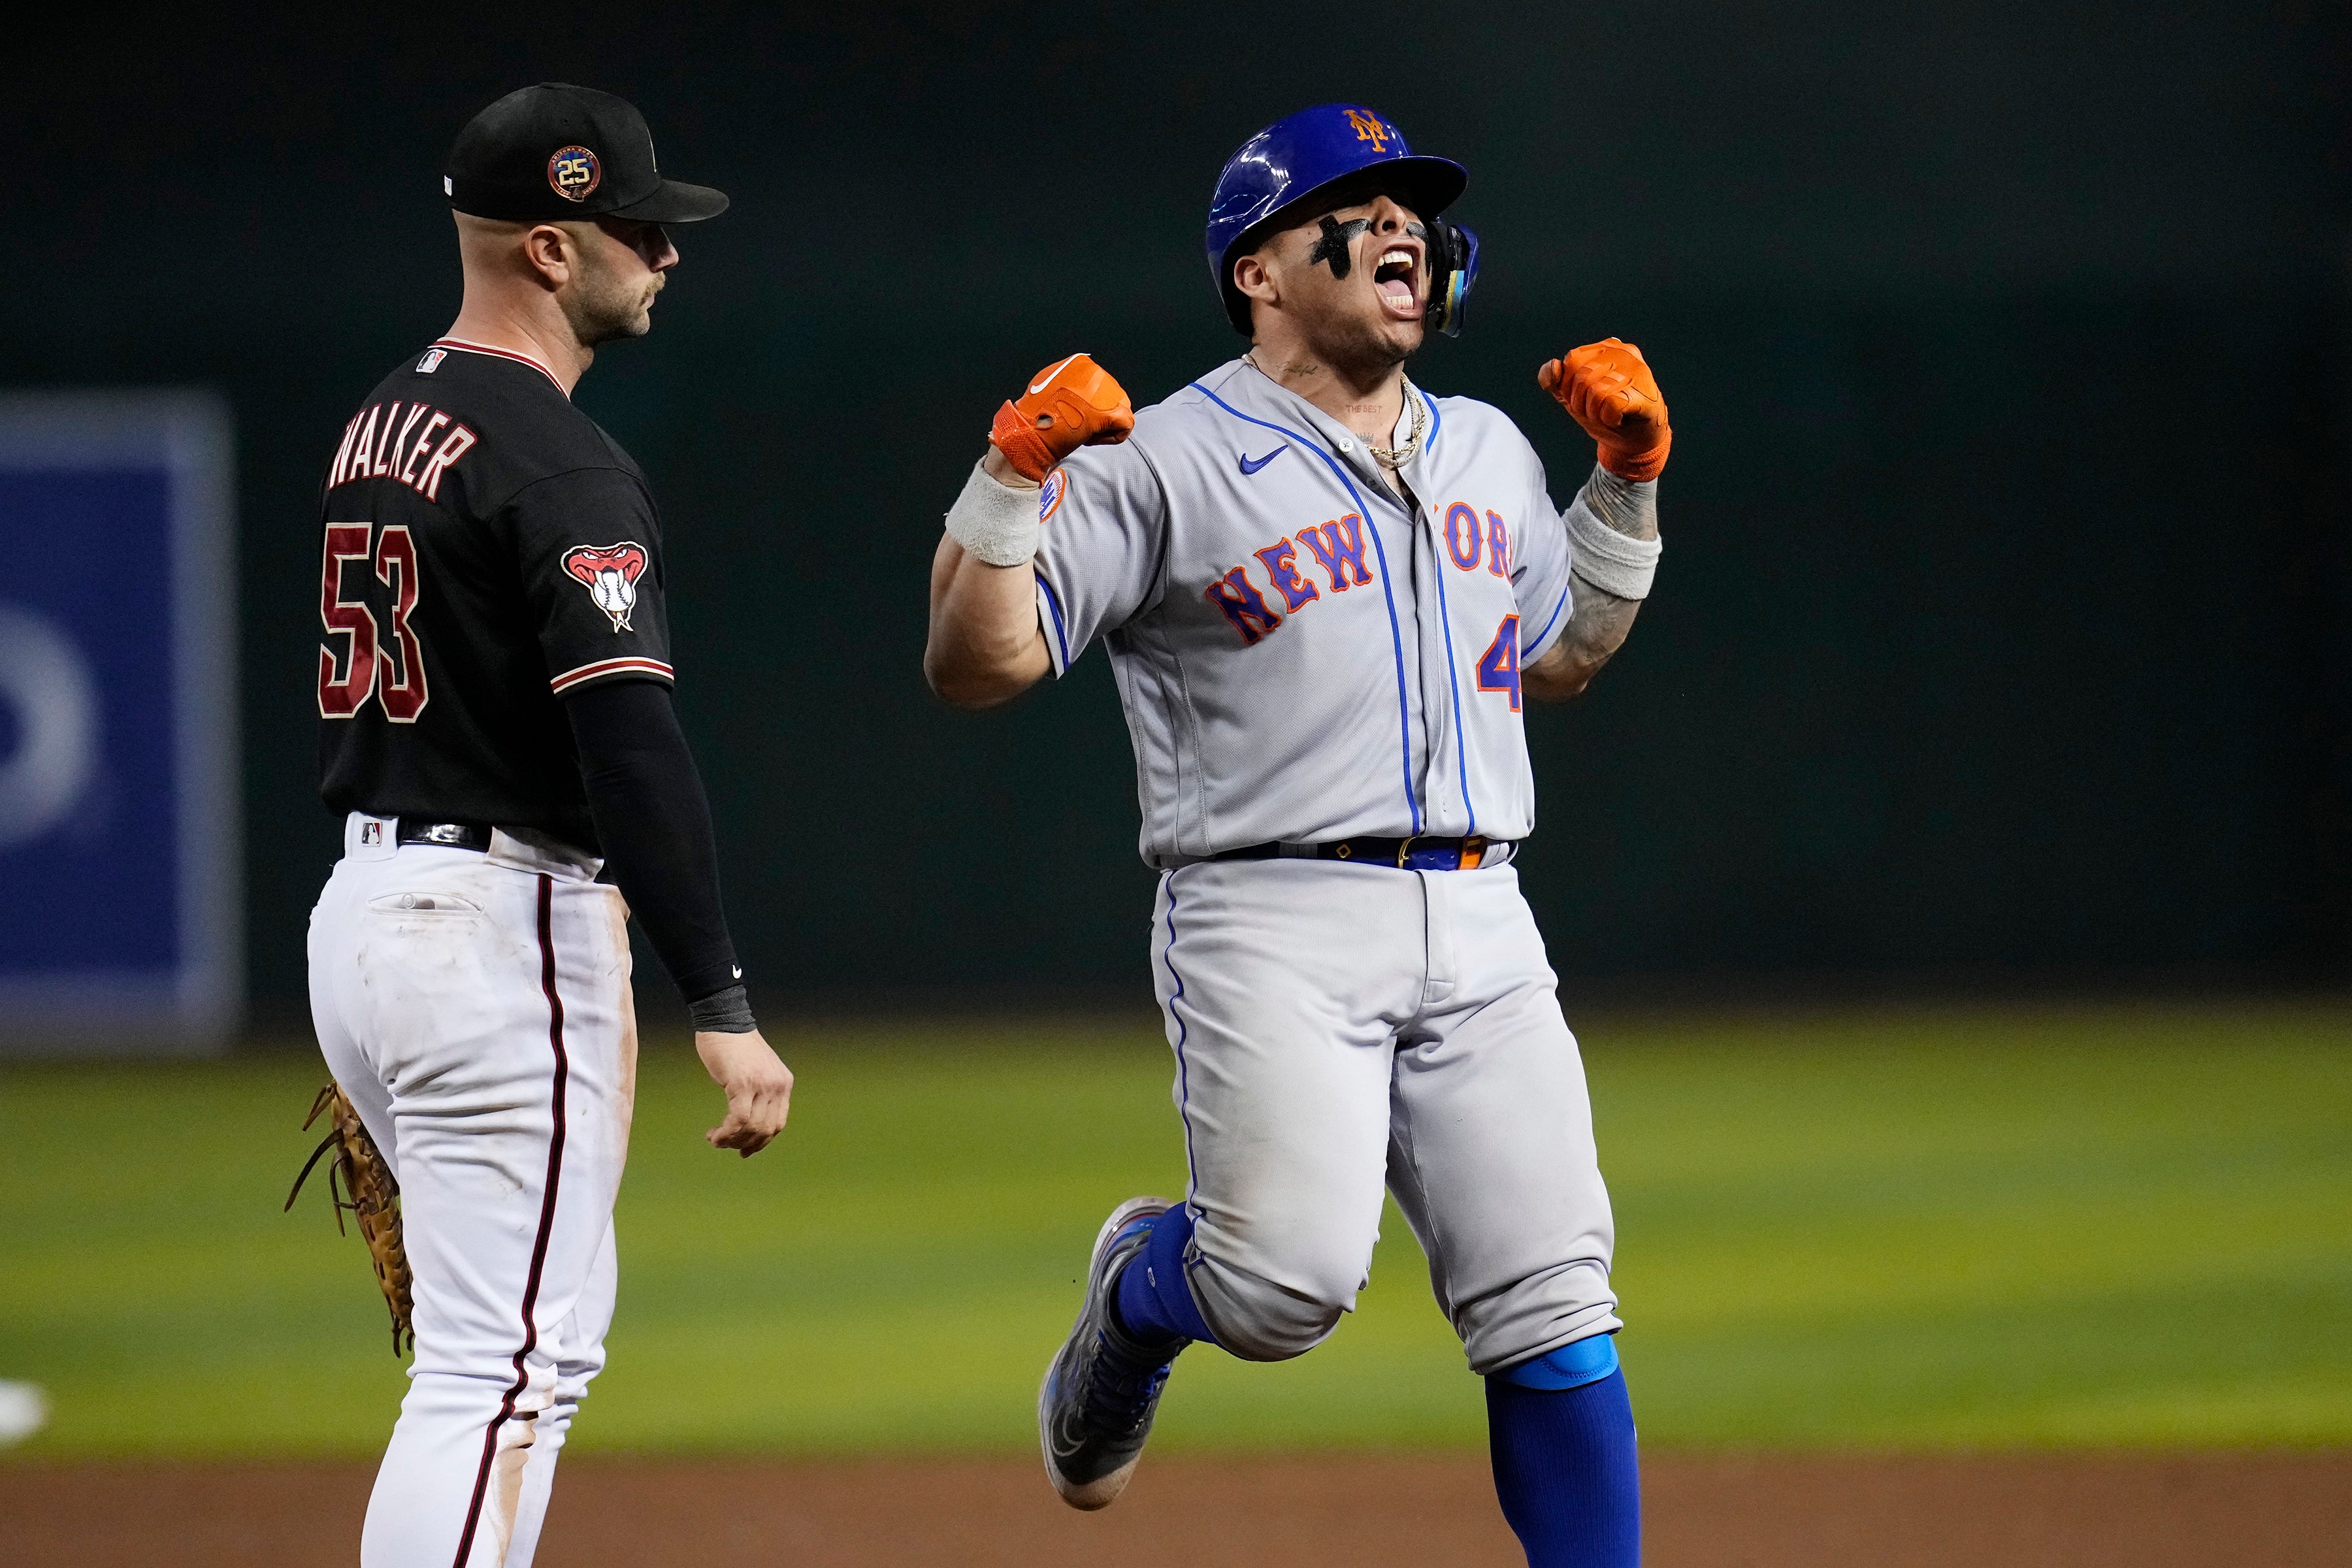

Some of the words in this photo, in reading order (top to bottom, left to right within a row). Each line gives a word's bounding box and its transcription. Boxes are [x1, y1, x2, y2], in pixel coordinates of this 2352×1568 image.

[551, 147, 575, 163] ARIZONA
[557, 157, 591, 186] 25
[328, 400, 478, 503] WALKER
[1346, 404, 1362, 414] THE
[1363, 404, 1383, 414] BEST
[318, 521, 429, 723] 53
[1205, 513, 1373, 645] NEW
[1434, 501, 1513, 585] OR
[1475, 613, 1522, 713] 4
